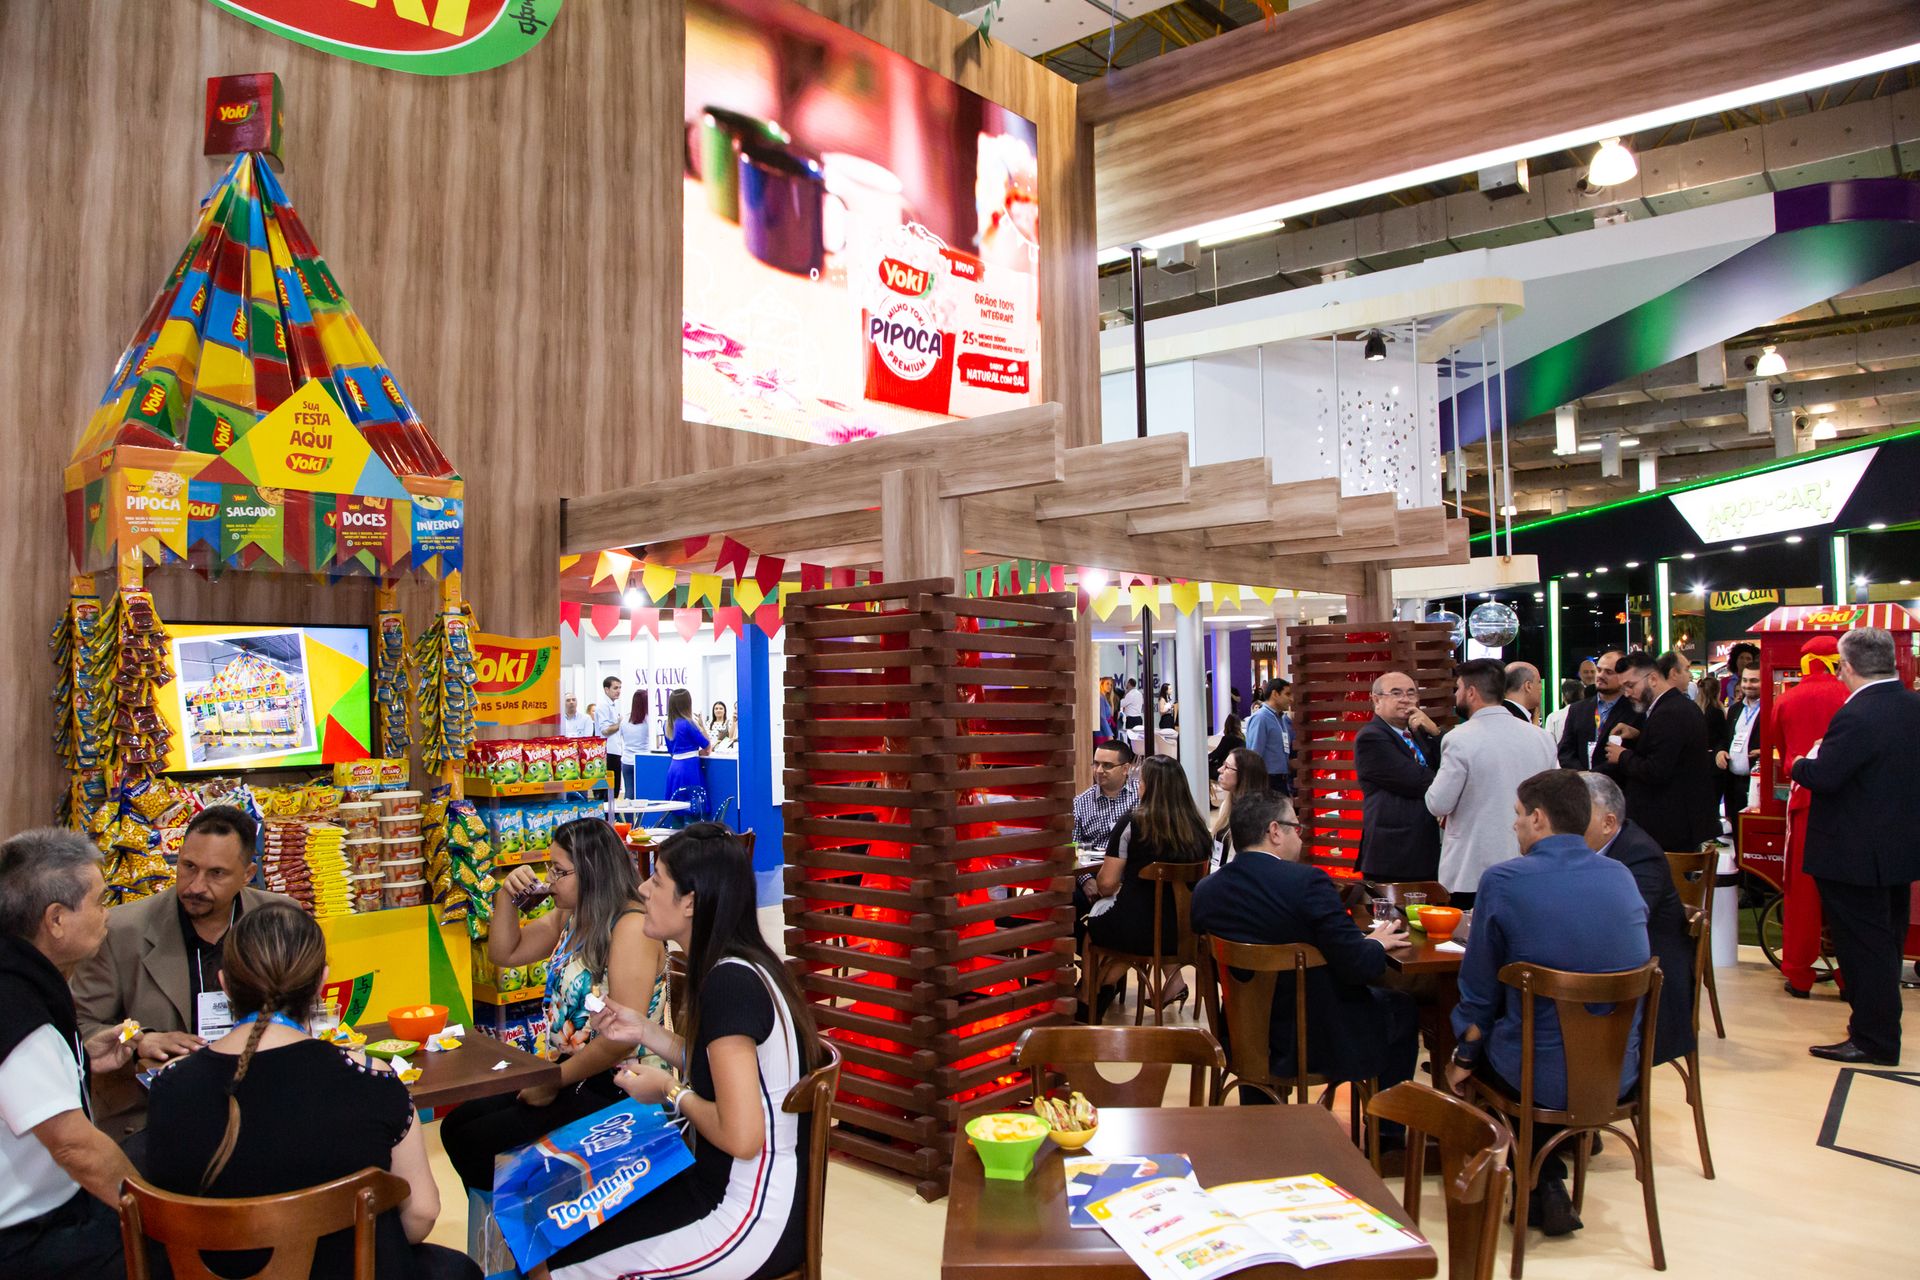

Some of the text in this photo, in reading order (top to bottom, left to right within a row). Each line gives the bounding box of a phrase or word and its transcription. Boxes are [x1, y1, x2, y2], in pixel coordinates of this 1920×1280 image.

[220, 105, 249, 120] Yoki
[955, 261, 975, 275] NOVO
[883, 260, 924, 293] Yoki
[999, 299, 1015, 312] 100%
[887, 303, 925, 327] MILHO YOKI
[980, 309, 1014, 324] INTEGRAIS
[870, 318, 941, 357] PIPOCA
[887, 350, 927, 373] PREMIUM
[966, 368, 999, 384] NATURAL
[1013, 375, 1025, 387] SAL
[142, 386, 166, 413] Yoki
[303, 401, 319, 411] SUA
[294, 413, 331, 426] FESTA
[215, 419, 231, 449] Yoki
[289, 430, 332, 450] AQUI
[290, 455, 324, 471] Yoki
[126, 495, 181, 511] PIPOCA
[226, 506, 276, 517] SALGADO
[342, 511, 387, 527] DOCES
[416, 520, 460, 531] INVERNO
[1807, 611, 1850, 624] Yoki
[635, 667, 688, 685] SNCKING
[496, 701, 519, 710] SUAS
[168, 810, 188, 828] Yoki
[550, 1160, 647, 1226] Toquinho
